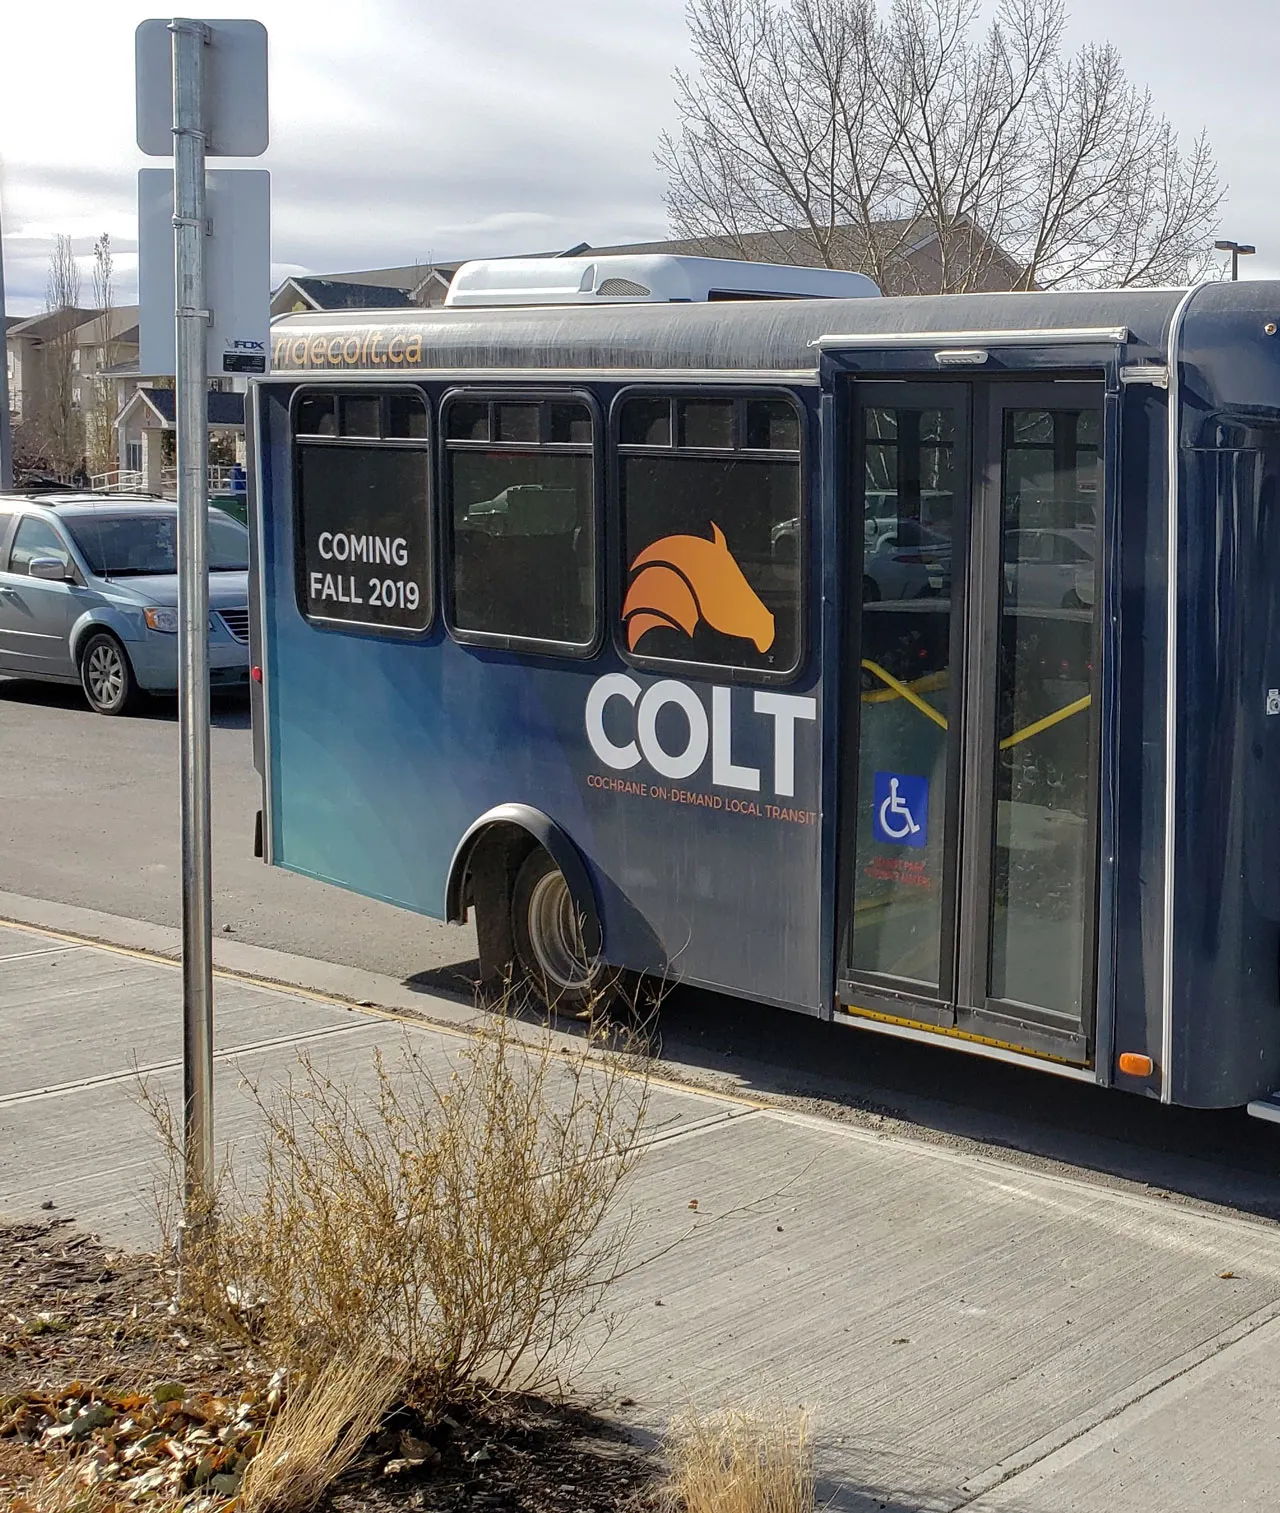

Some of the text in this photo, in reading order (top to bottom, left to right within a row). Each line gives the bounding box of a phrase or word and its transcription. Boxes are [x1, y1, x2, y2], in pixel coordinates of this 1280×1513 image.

[274, 331, 422, 364] ridecolt.ca
[318, 531, 408, 566] COMING
[310, 572, 420, 610] FALL 2019
[585, 672, 817, 797] COLT
[587, 775, 818, 826] COCHRANE ON-DEMAND LOCAL TRANSIT
